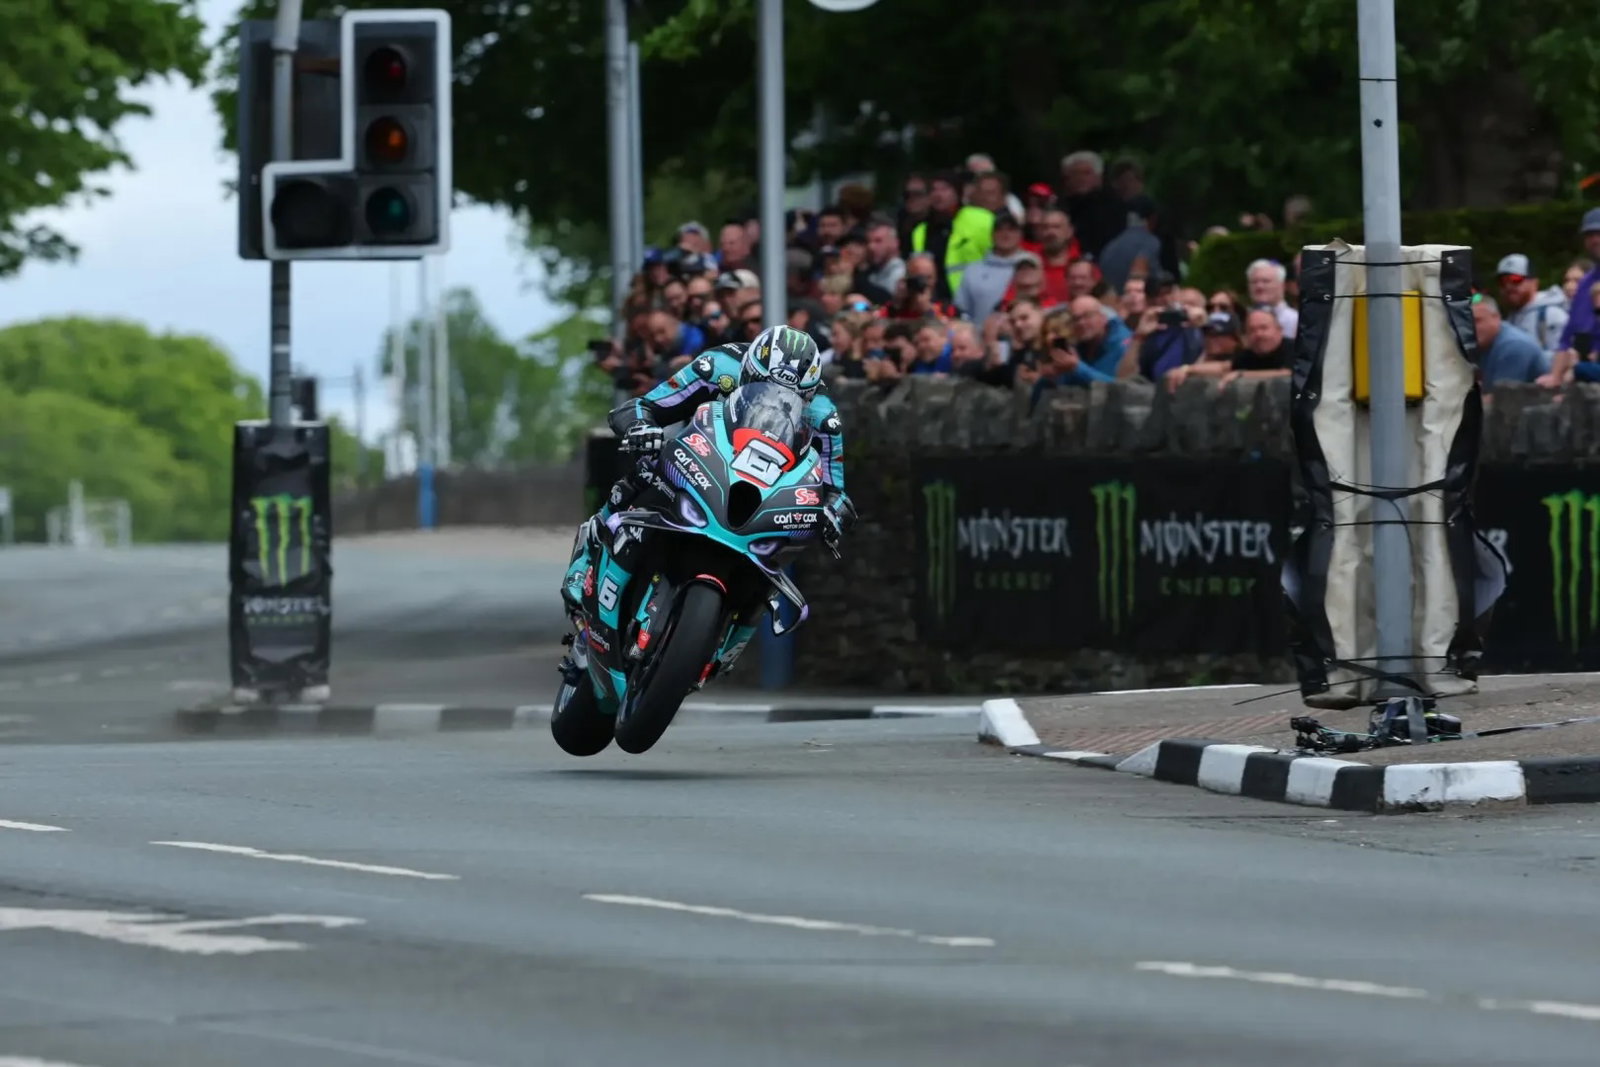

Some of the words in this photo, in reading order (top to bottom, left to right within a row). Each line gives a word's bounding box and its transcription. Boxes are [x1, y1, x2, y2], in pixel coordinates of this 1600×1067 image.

[775, 369, 797, 384] Arai
[674, 448, 693, 466] carl
[694, 472, 712, 490] cox
[730, 439, 788, 486] 6
[773, 512, 793, 524] carl
[803, 513, 818, 523] cox
[958, 508, 1071, 561] MONSTER
[1140, 511, 1275, 567] MONSTER
[599, 576, 618, 611] 6
